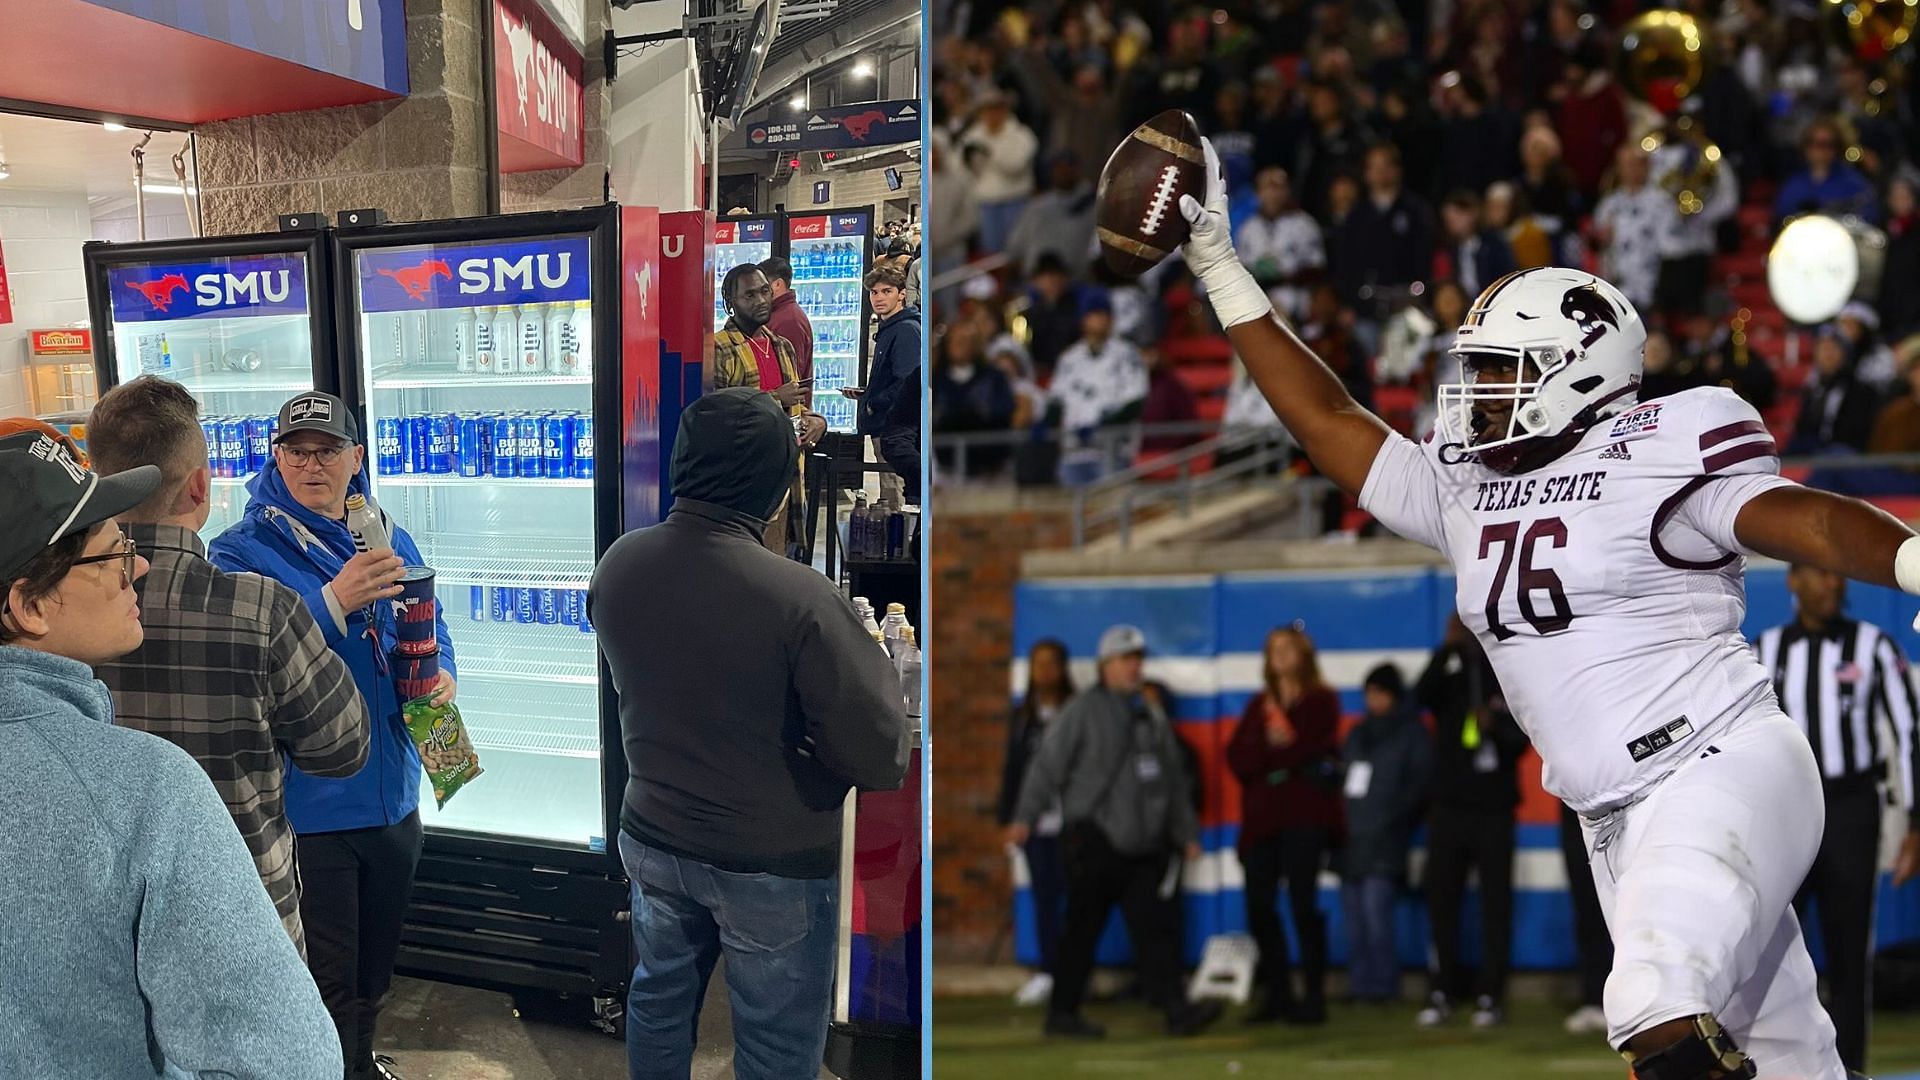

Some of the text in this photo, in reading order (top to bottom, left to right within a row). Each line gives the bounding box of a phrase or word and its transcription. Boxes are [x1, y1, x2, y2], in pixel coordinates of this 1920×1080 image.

[536, 40, 567, 133] SMU
[807, 123, 839, 132] Concessions
[839, 217, 858, 225] SMU
[458, 252, 571, 294] SMU
[194, 270, 290, 307] SMU
[41, 334, 82, 346] Bavarian
[1611, 417, 1660, 433] RESPONDER
[221, 441, 242, 451] BUD
[498, 439, 517, 448] BU
[578, 439, 594, 448] BU
[574, 448, 594, 457] LIG
[1598, 452, 1632, 461] adidas
[1473, 471, 1607, 512] TEXAS STATE
[1477, 516, 1575, 642] 76
[445, 756, 470, 783] salted
